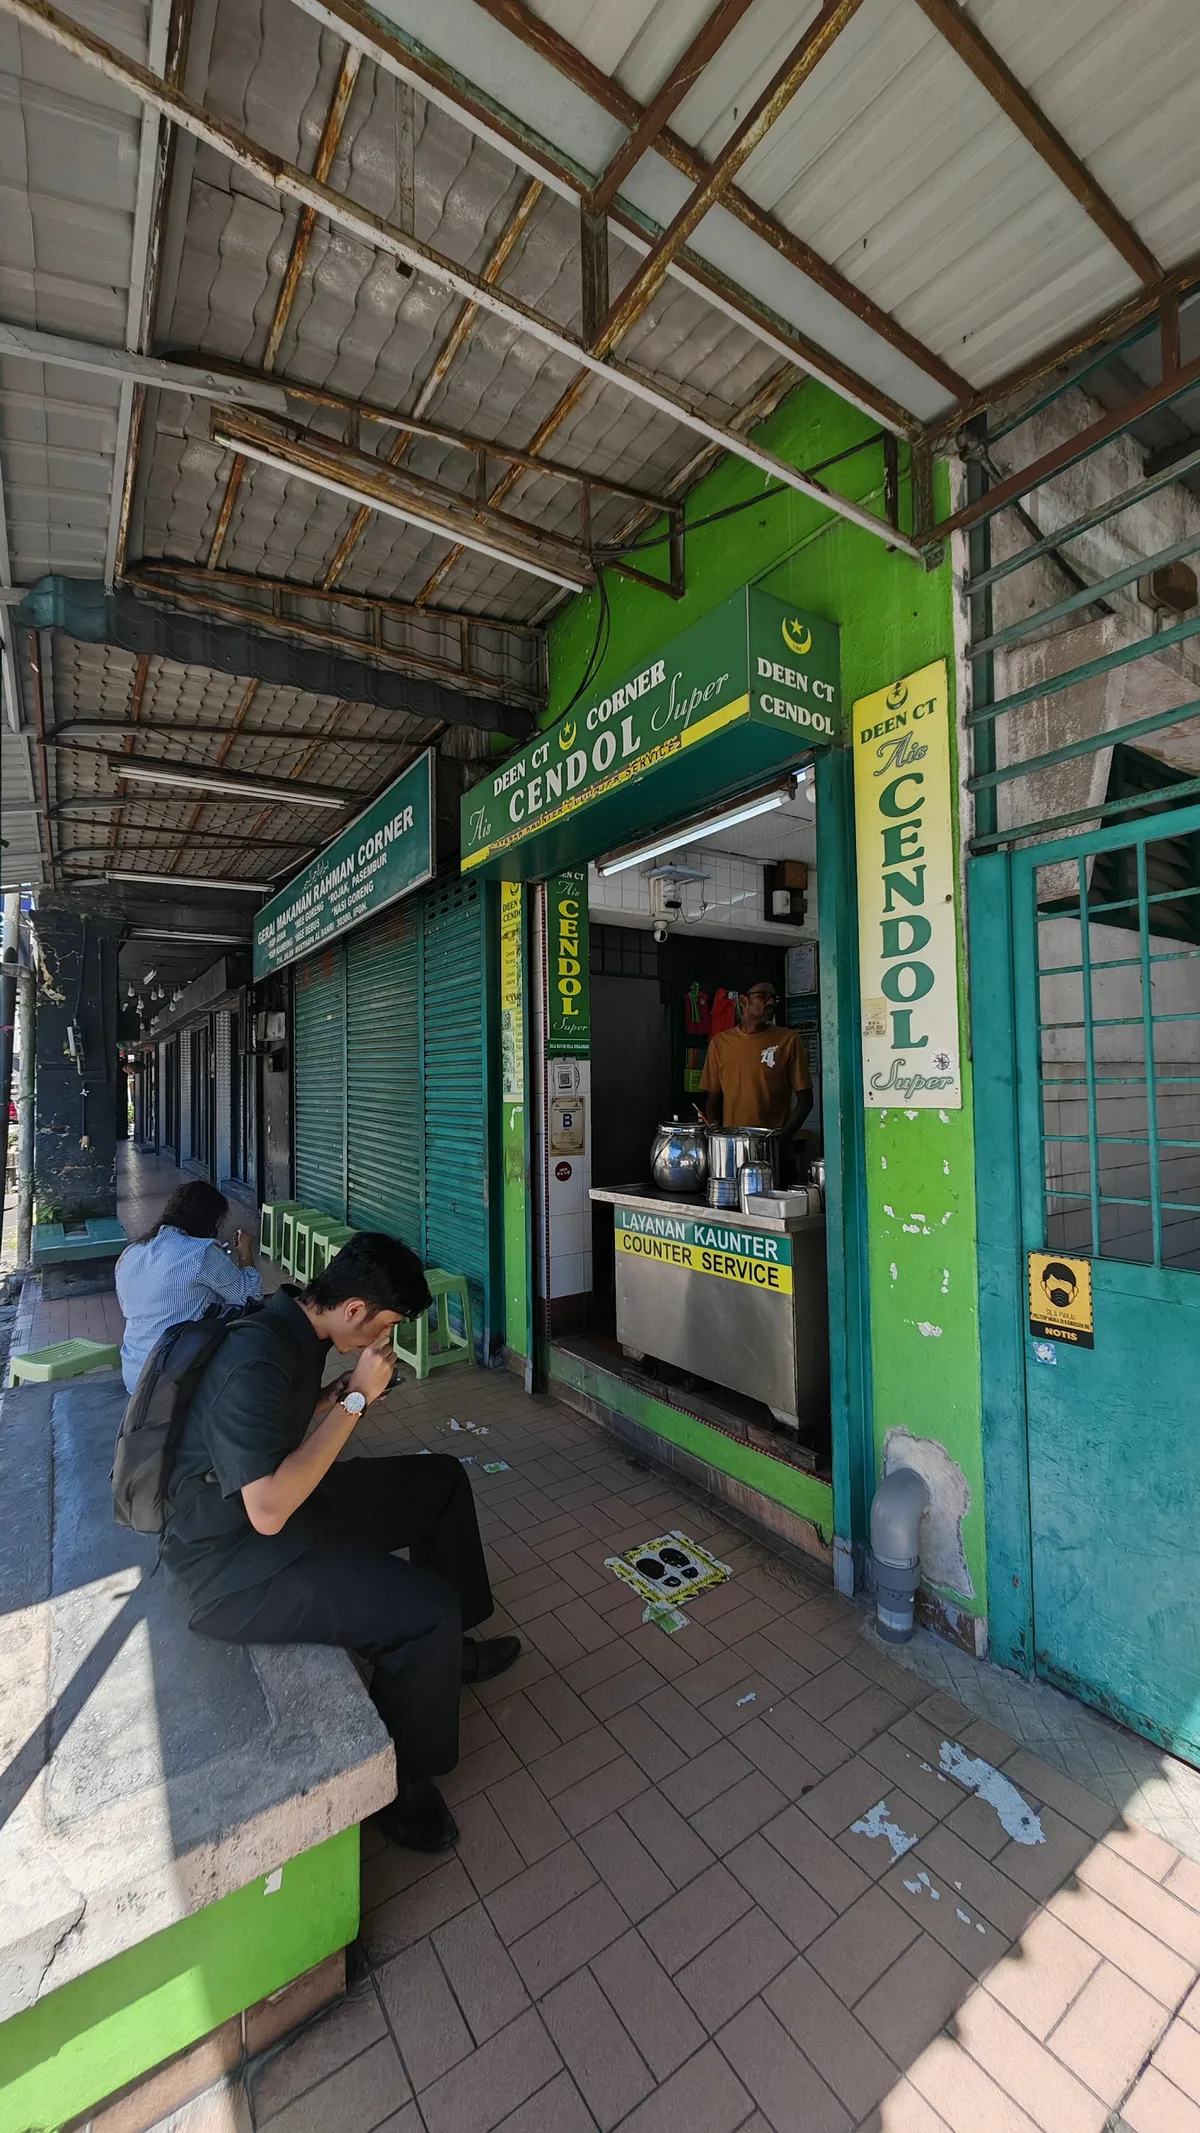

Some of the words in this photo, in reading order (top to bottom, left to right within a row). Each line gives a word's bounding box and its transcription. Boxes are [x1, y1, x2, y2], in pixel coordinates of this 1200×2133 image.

[757, 656, 808, 693] DEEN
[812, 679, 835, 702] CT
[493, 759, 526, 798] DEEN
[531, 741, 550, 769] CT
[586, 659, 667, 731] CORNER
[759, 693, 835, 736] CENDOL
[860, 711, 907, 745] DEEN
[912, 697, 937, 720] CT
[467, 805, 492, 846] Ais
[508, 715, 641, 823] CENDOL
[651, 671, 730, 731] Super
[873, 731, 928, 776] Ais
[257, 920, 275, 946] GERAI
[276, 893, 312, 932] MAKANAN
[313, 853, 355, 901] RAHMAN
[357, 804, 414, 866] CORNER
[352, 852, 387, 888] PASEMBUR
[574, 872, 585, 881] CT
[347, 880, 374, 907] GORENG
[503, 899, 518, 913] DEEN
[878, 771, 936, 1050] CENDOL
[557, 899, 582, 1016] CENDOL
[552, 1016, 588, 1039] Super
[870, 1058, 954, 1099] Super
[562, 1113, 573, 1128] B
[622, 1212, 686, 1241] LAYANAN
[694, 1224, 779, 1261] KAUNTER
[623, 1234, 693, 1266] COUNTER
[701, 1252, 780, 1288] SERVICE
[1044, 1326, 1078, 1341] NOTIS
